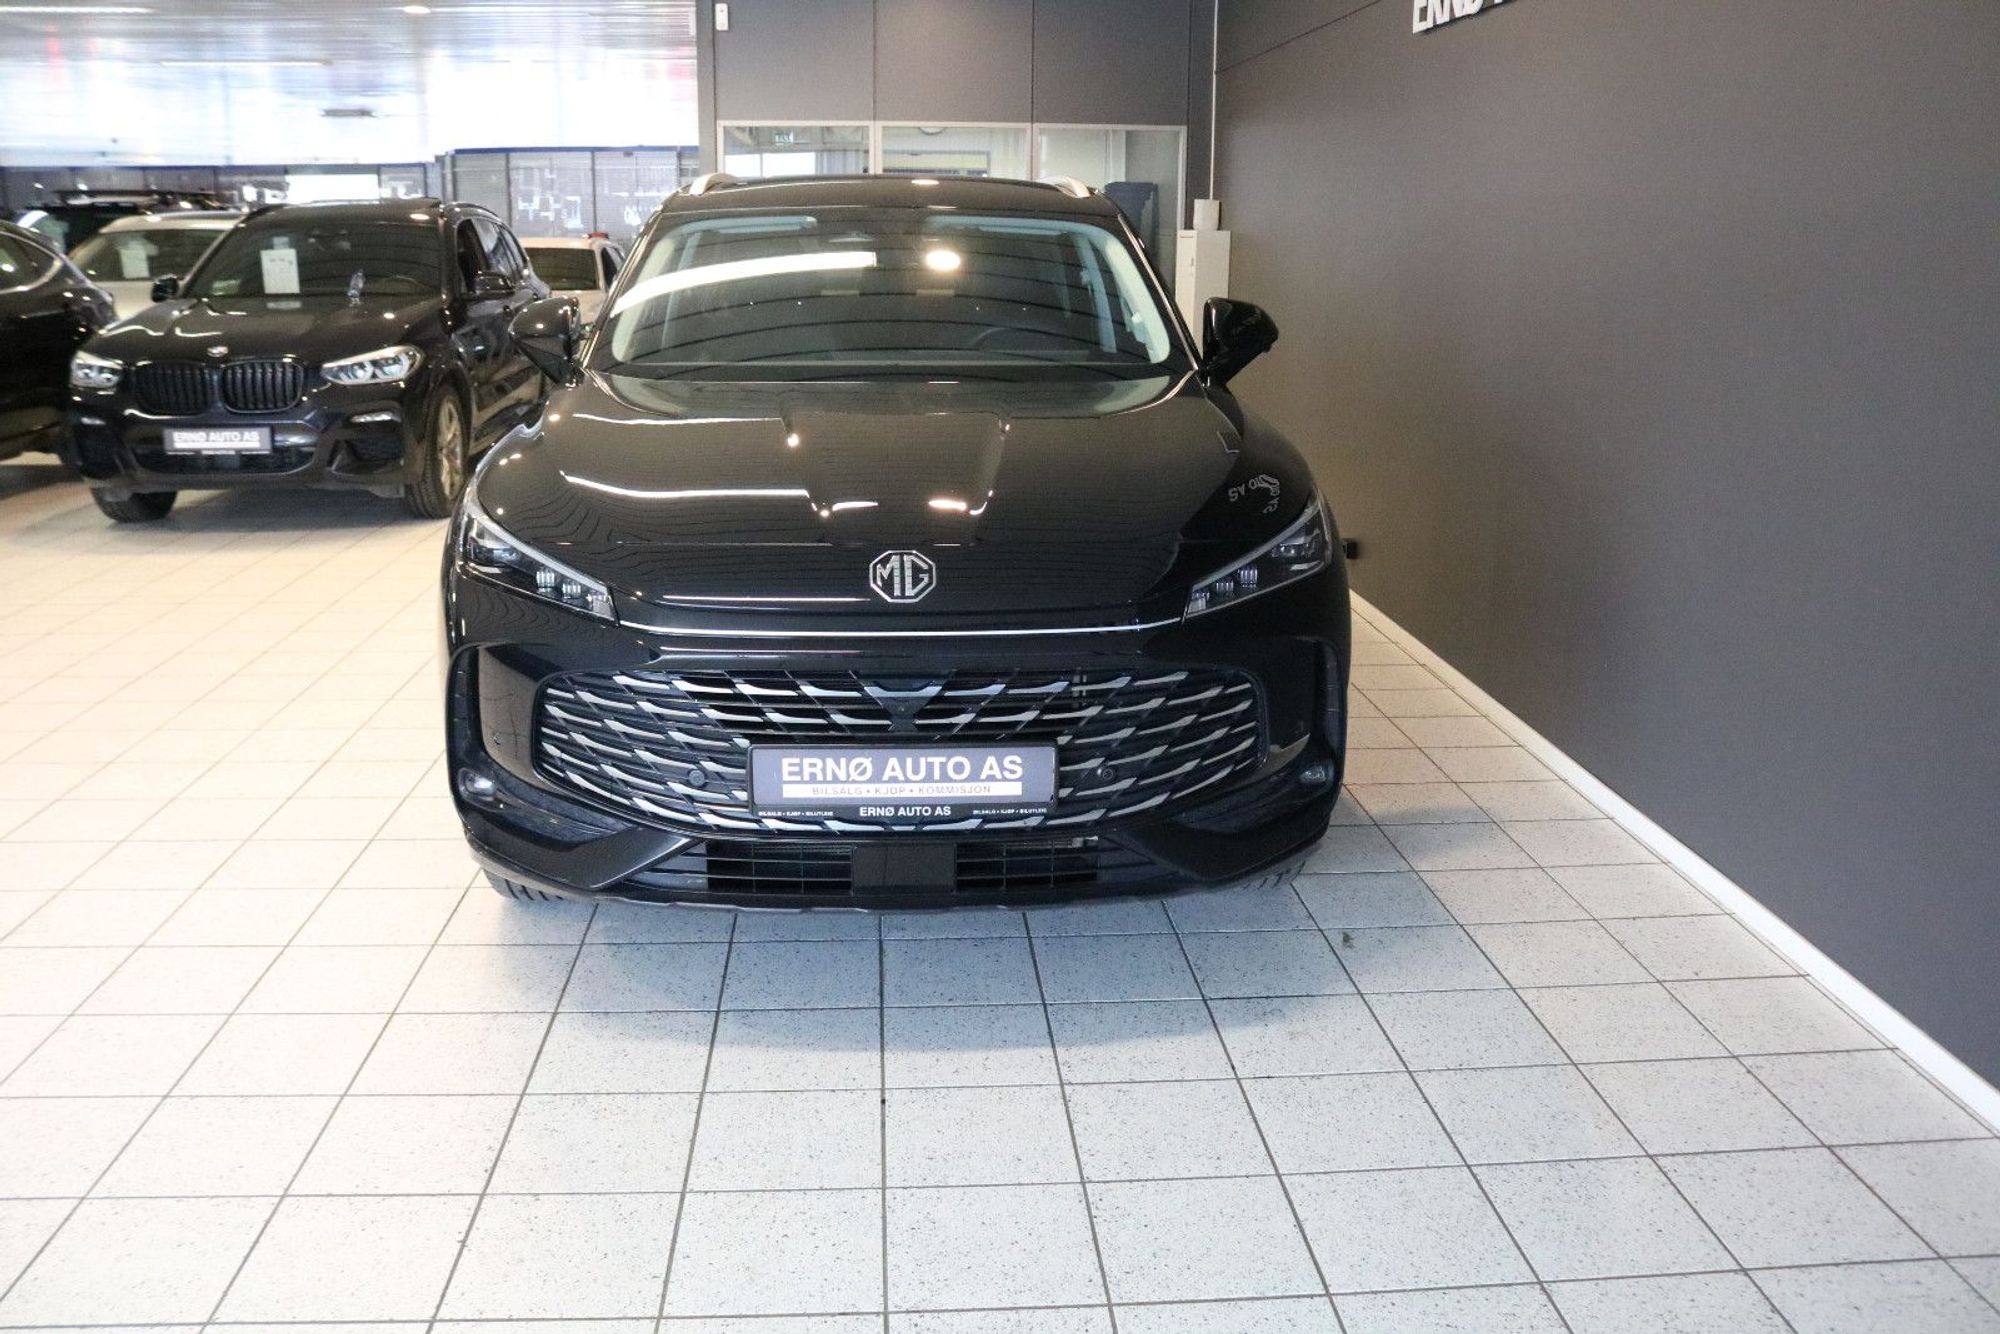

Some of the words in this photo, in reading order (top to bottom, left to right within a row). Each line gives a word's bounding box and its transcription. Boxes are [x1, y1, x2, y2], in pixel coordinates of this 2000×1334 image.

[876, 554, 929, 597] MG
[782, 757, 873, 781] ERNØ
[882, 755, 971, 781] AUTO
[980, 754, 1023, 780] AS
[812, 787, 863, 796] BILSALG
[918, 785, 991, 795] KOMMISJON
[860, 806, 895, 816] ERNØ
[897, 806, 932, 816] AUTO
[934, 806, 951, 816] AS
